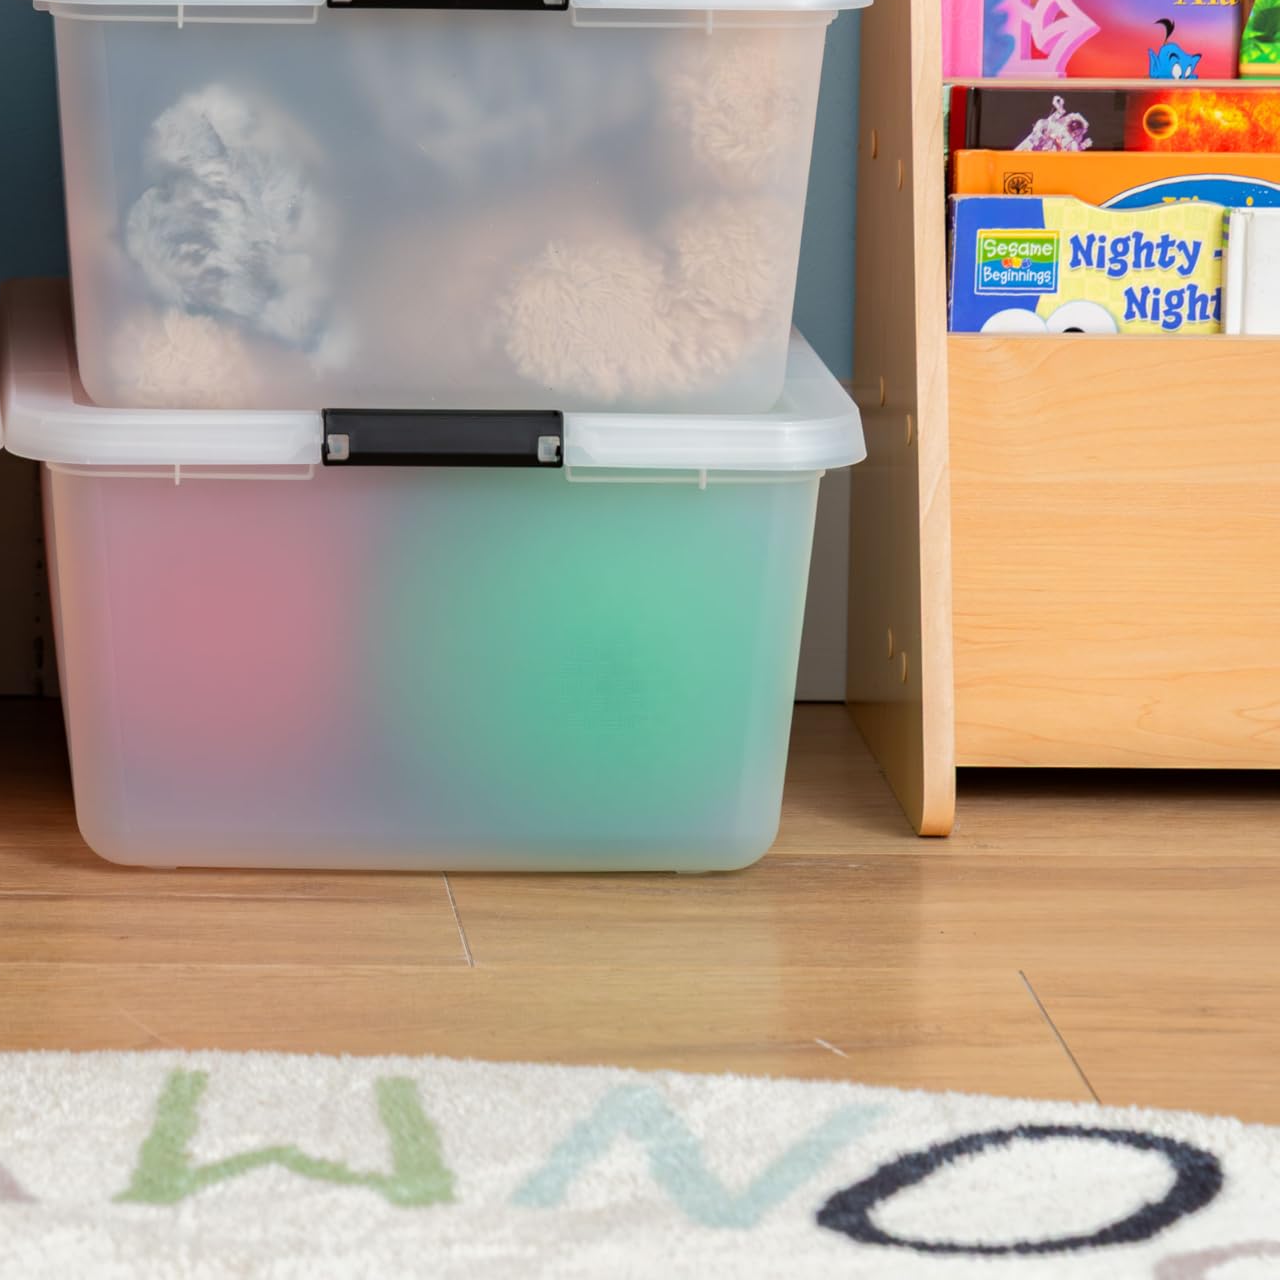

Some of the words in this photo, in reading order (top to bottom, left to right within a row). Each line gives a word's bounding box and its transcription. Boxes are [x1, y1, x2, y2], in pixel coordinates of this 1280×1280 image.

[983, 238, 1054, 258] Sesame
[1069, 231, 1203, 278] Nighty
[983, 265, 1052, 286] Beginnings
